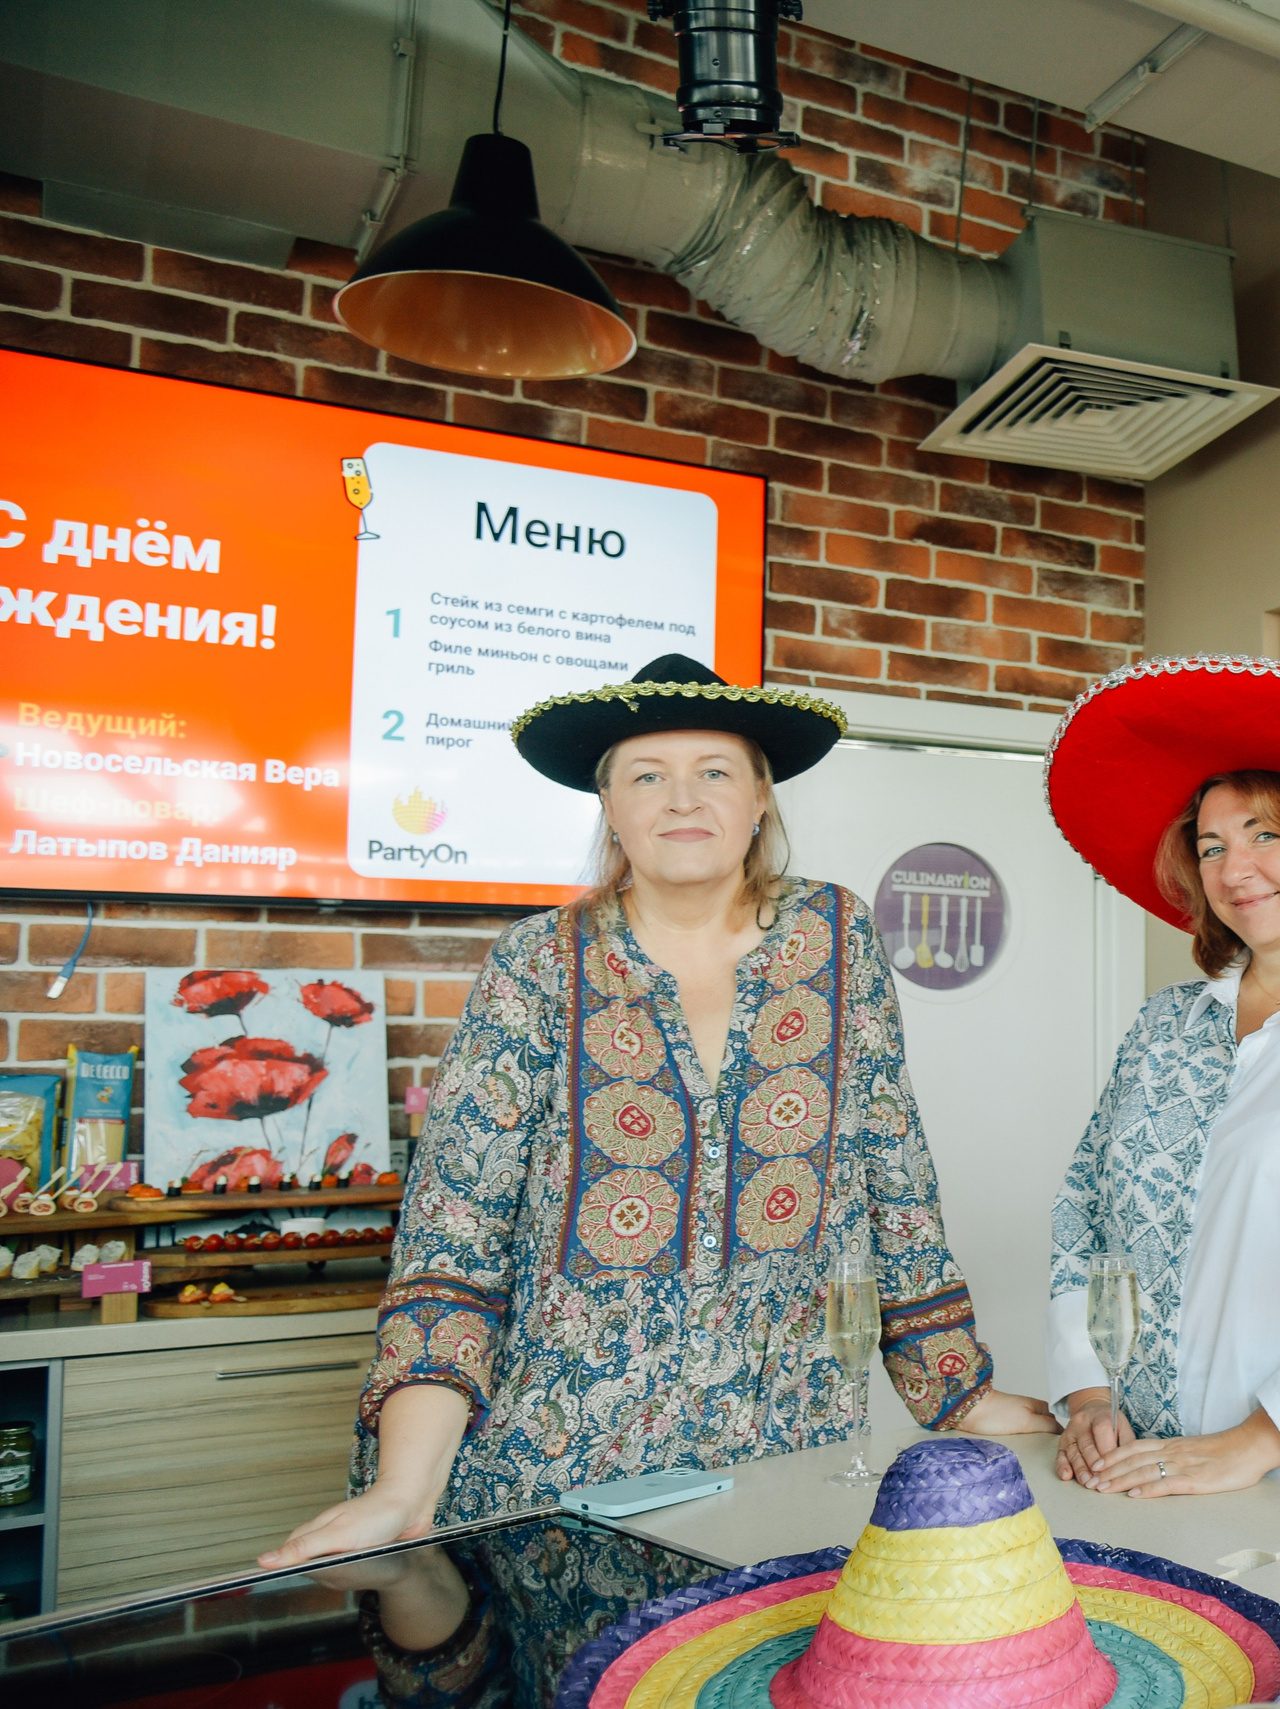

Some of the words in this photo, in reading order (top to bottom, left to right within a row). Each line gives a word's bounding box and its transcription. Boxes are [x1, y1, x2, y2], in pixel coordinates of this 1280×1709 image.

[42, 518, 221, 574] днём
[475, 501, 626, 559] Меню
[385, 608, 402, 638] 1
[429, 614, 489, 630] соусом
[494, 621, 513, 633] из
[517, 621, 571, 639] белого
[575, 631, 611, 643] вина
[430, 591, 479, 610] Стейк
[484, 601, 503, 612] из
[507, 604, 554, 618] семги
[559, 610, 568, 620] с
[572, 611, 665, 631] картофелем
[669, 622, 696, 636] под
[428, 661, 475, 676] гриль
[429, 640, 473, 656] Филе
[477, 647, 538, 662] миньон
[543, 654, 552, 664] с
[556, 655, 629, 671] овощами
[18, 702, 187, 739] Ведущий:
[382, 709, 405, 742] 2
[426, 735, 473, 749] пирог
[14, 742, 257, 782] Новосельская
[265, 759, 340, 791] Вера
[9, 829, 168, 861] Латыпов
[174, 837, 297, 871] Данияр
[368, 840, 467, 868] PartyOn
